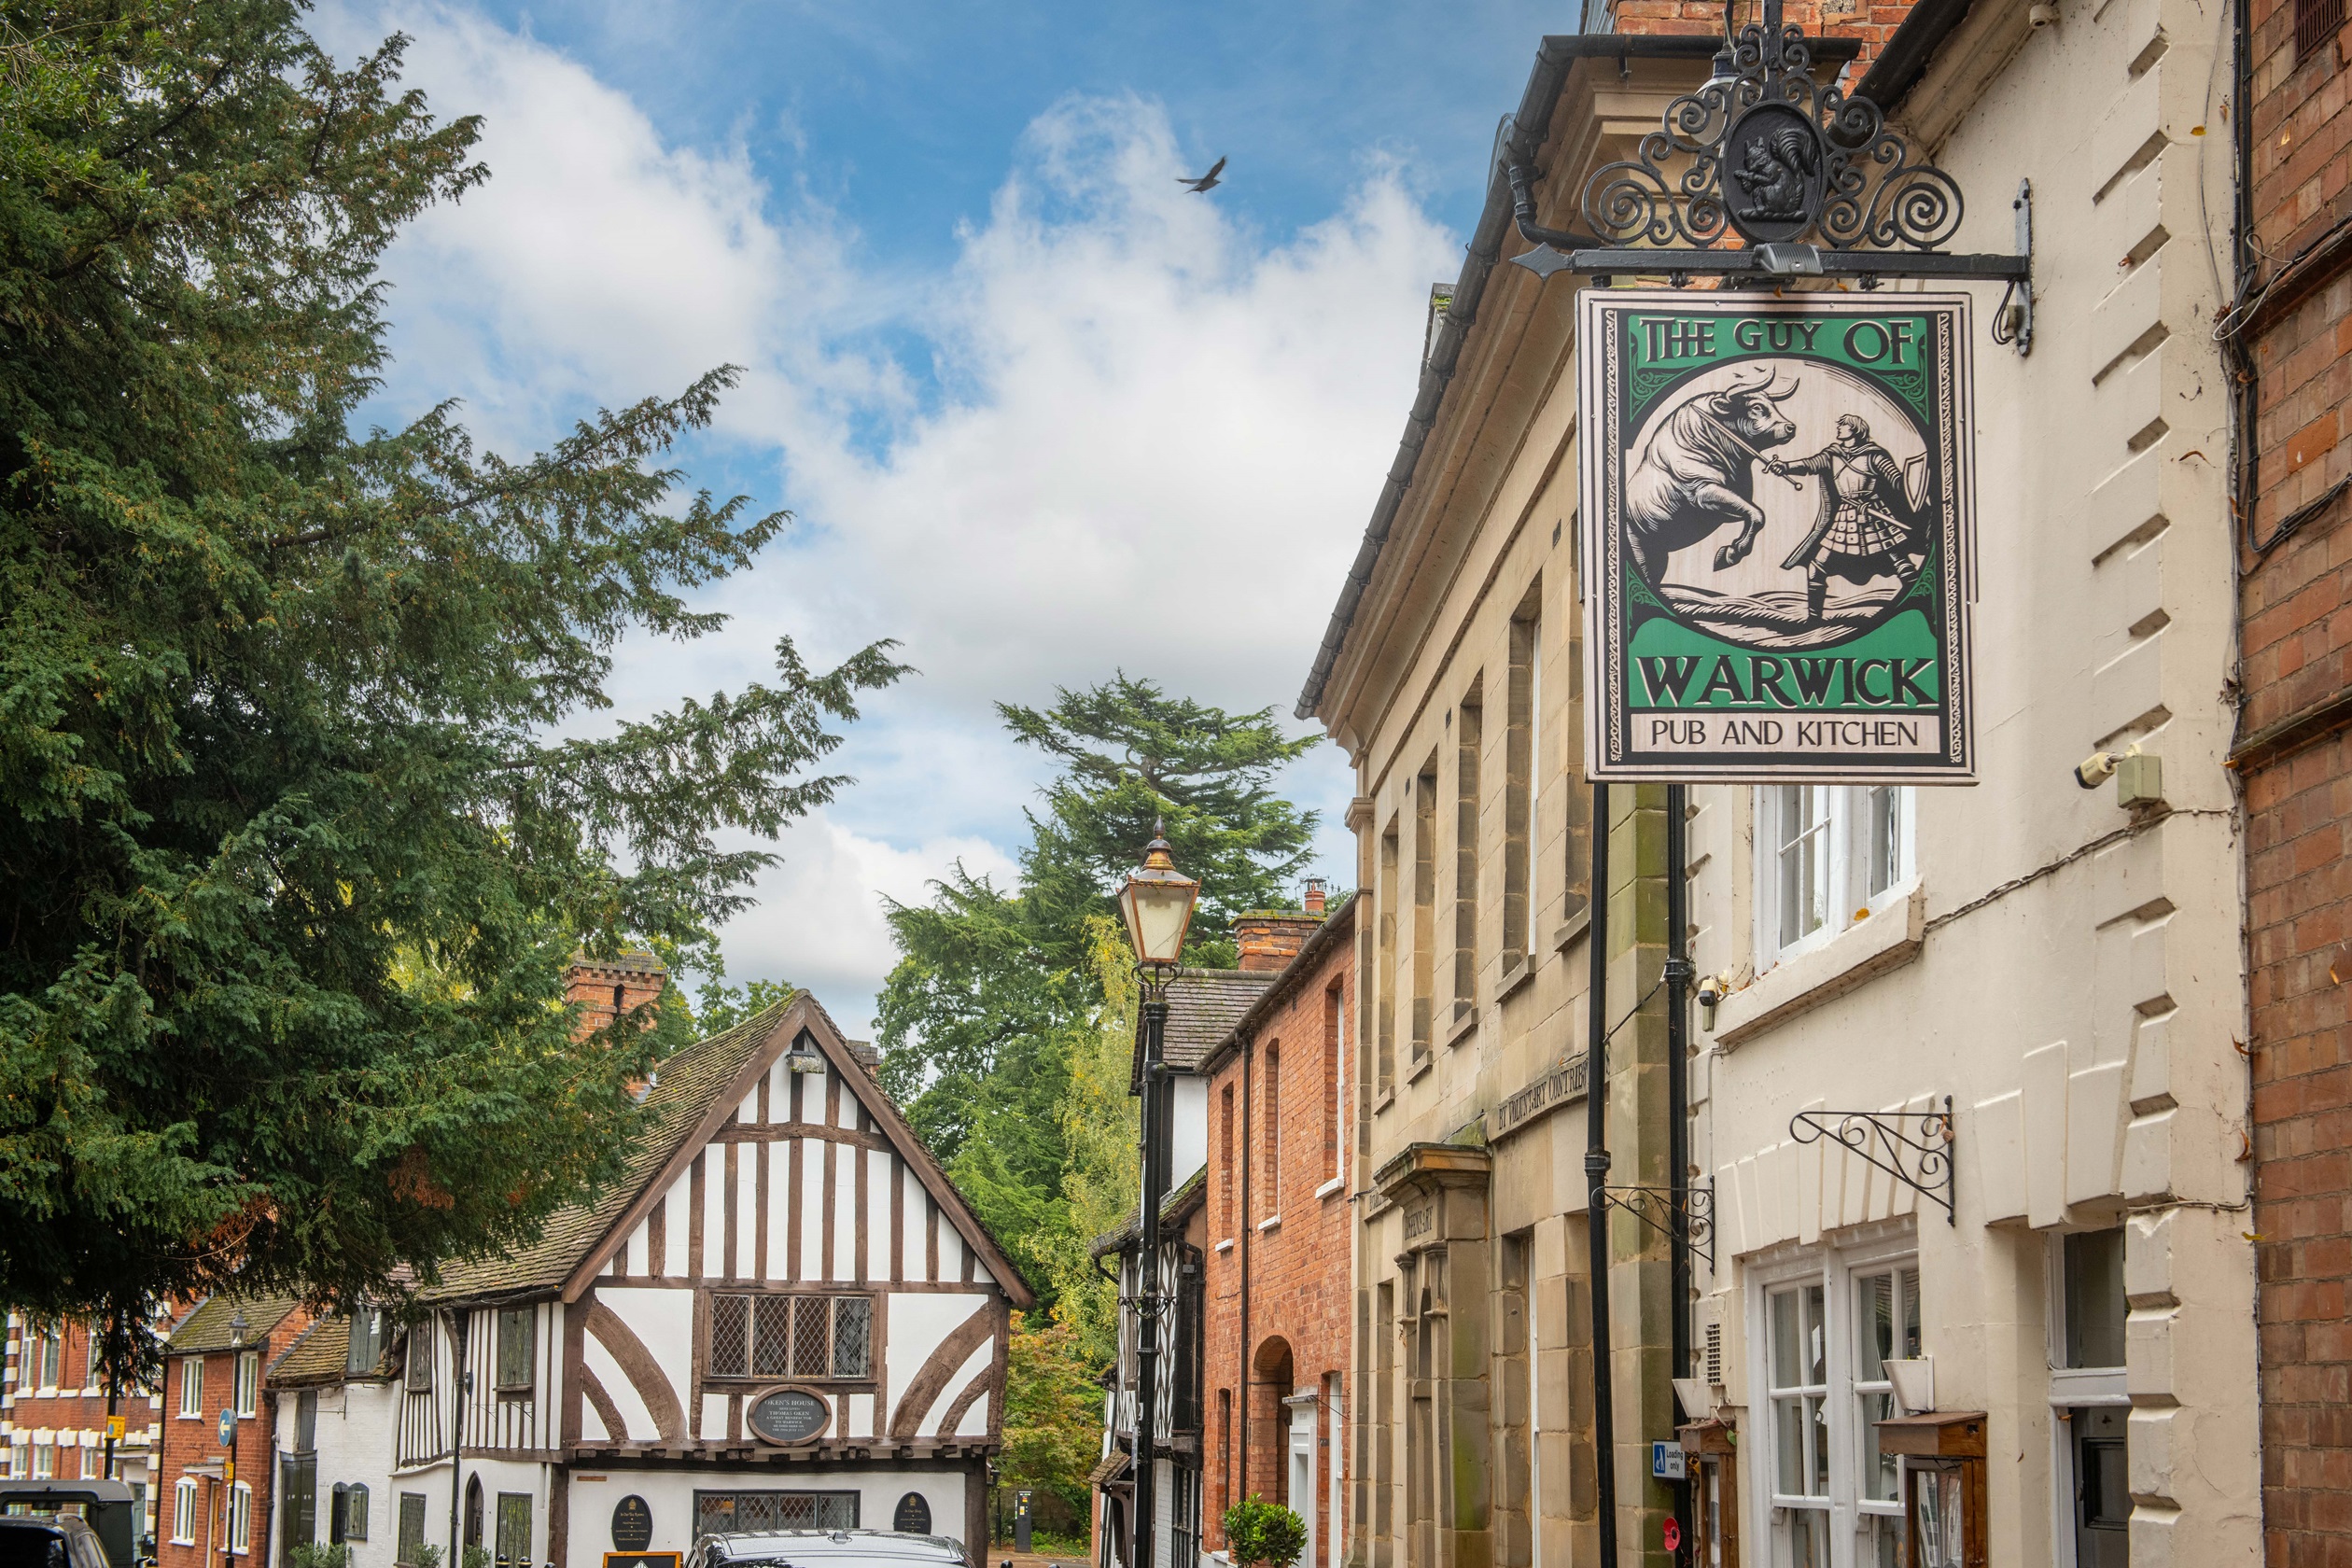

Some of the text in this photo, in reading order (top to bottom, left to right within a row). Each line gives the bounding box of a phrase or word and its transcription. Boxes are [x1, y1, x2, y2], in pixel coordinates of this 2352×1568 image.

[1640, 317, 1914, 365] THE GUY OF
[1635, 655, 1939, 708] WARWICK
[1651, 720, 1919, 749] PUB AND KITCHEN
[1498, 1057, 1589, 1130] BY VOLUNTARY CONTRIBU
[1666, 1449, 1683, 1460] Loading
[1670, 1462, 1680, 1471] only
